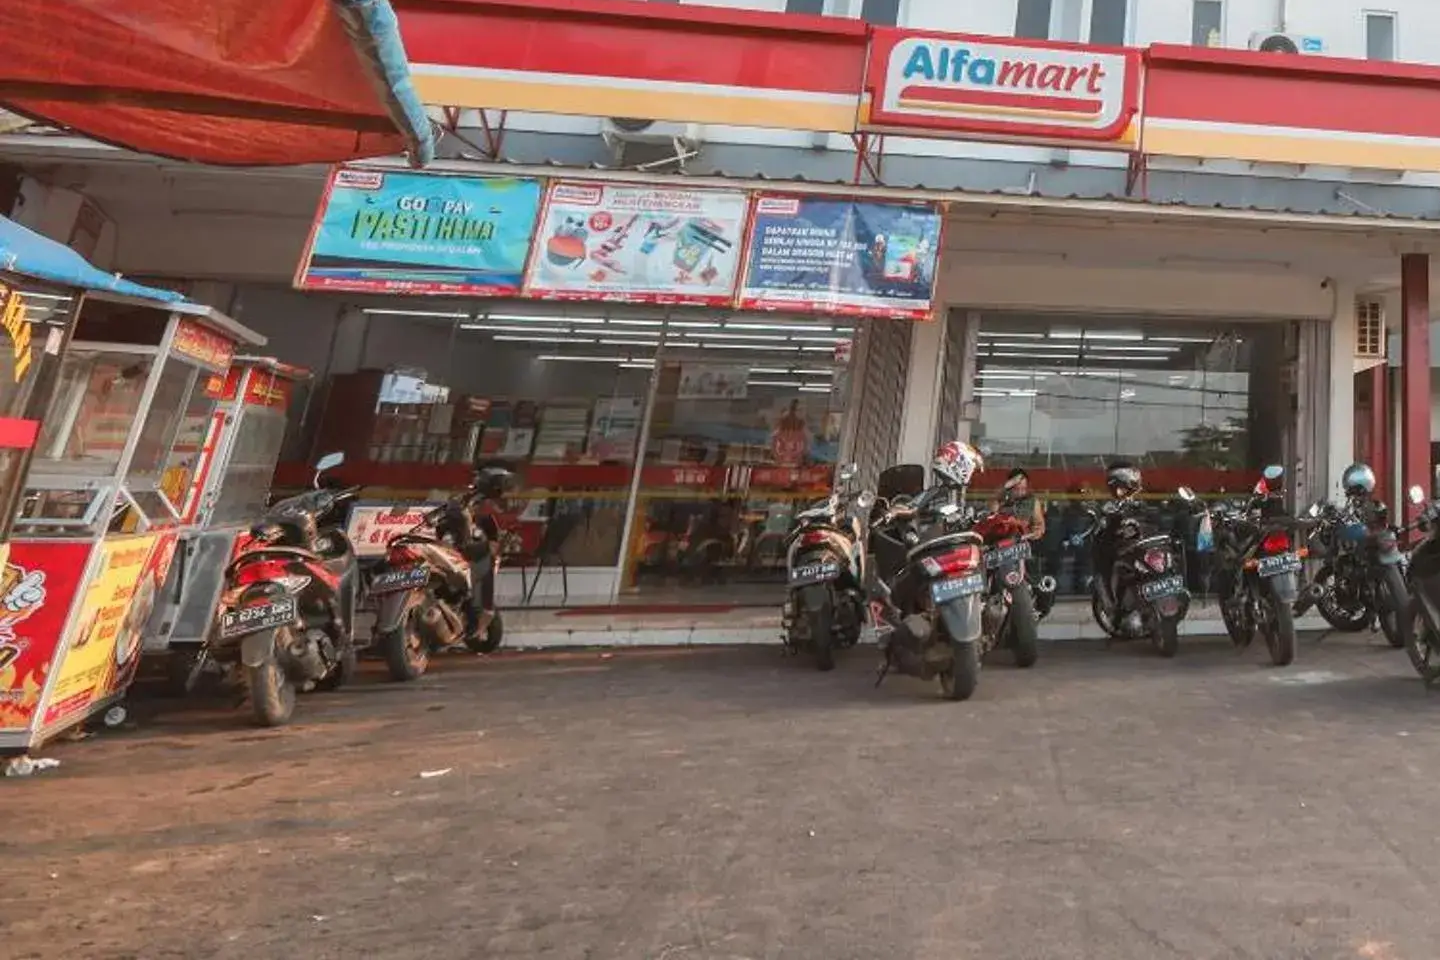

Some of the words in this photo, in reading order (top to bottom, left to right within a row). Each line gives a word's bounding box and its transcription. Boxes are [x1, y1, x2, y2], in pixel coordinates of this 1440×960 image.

[902, 44, 1106, 93] Alfamart
[398, 196, 426, 211] GO
[444, 199, 473, 215] PAY
